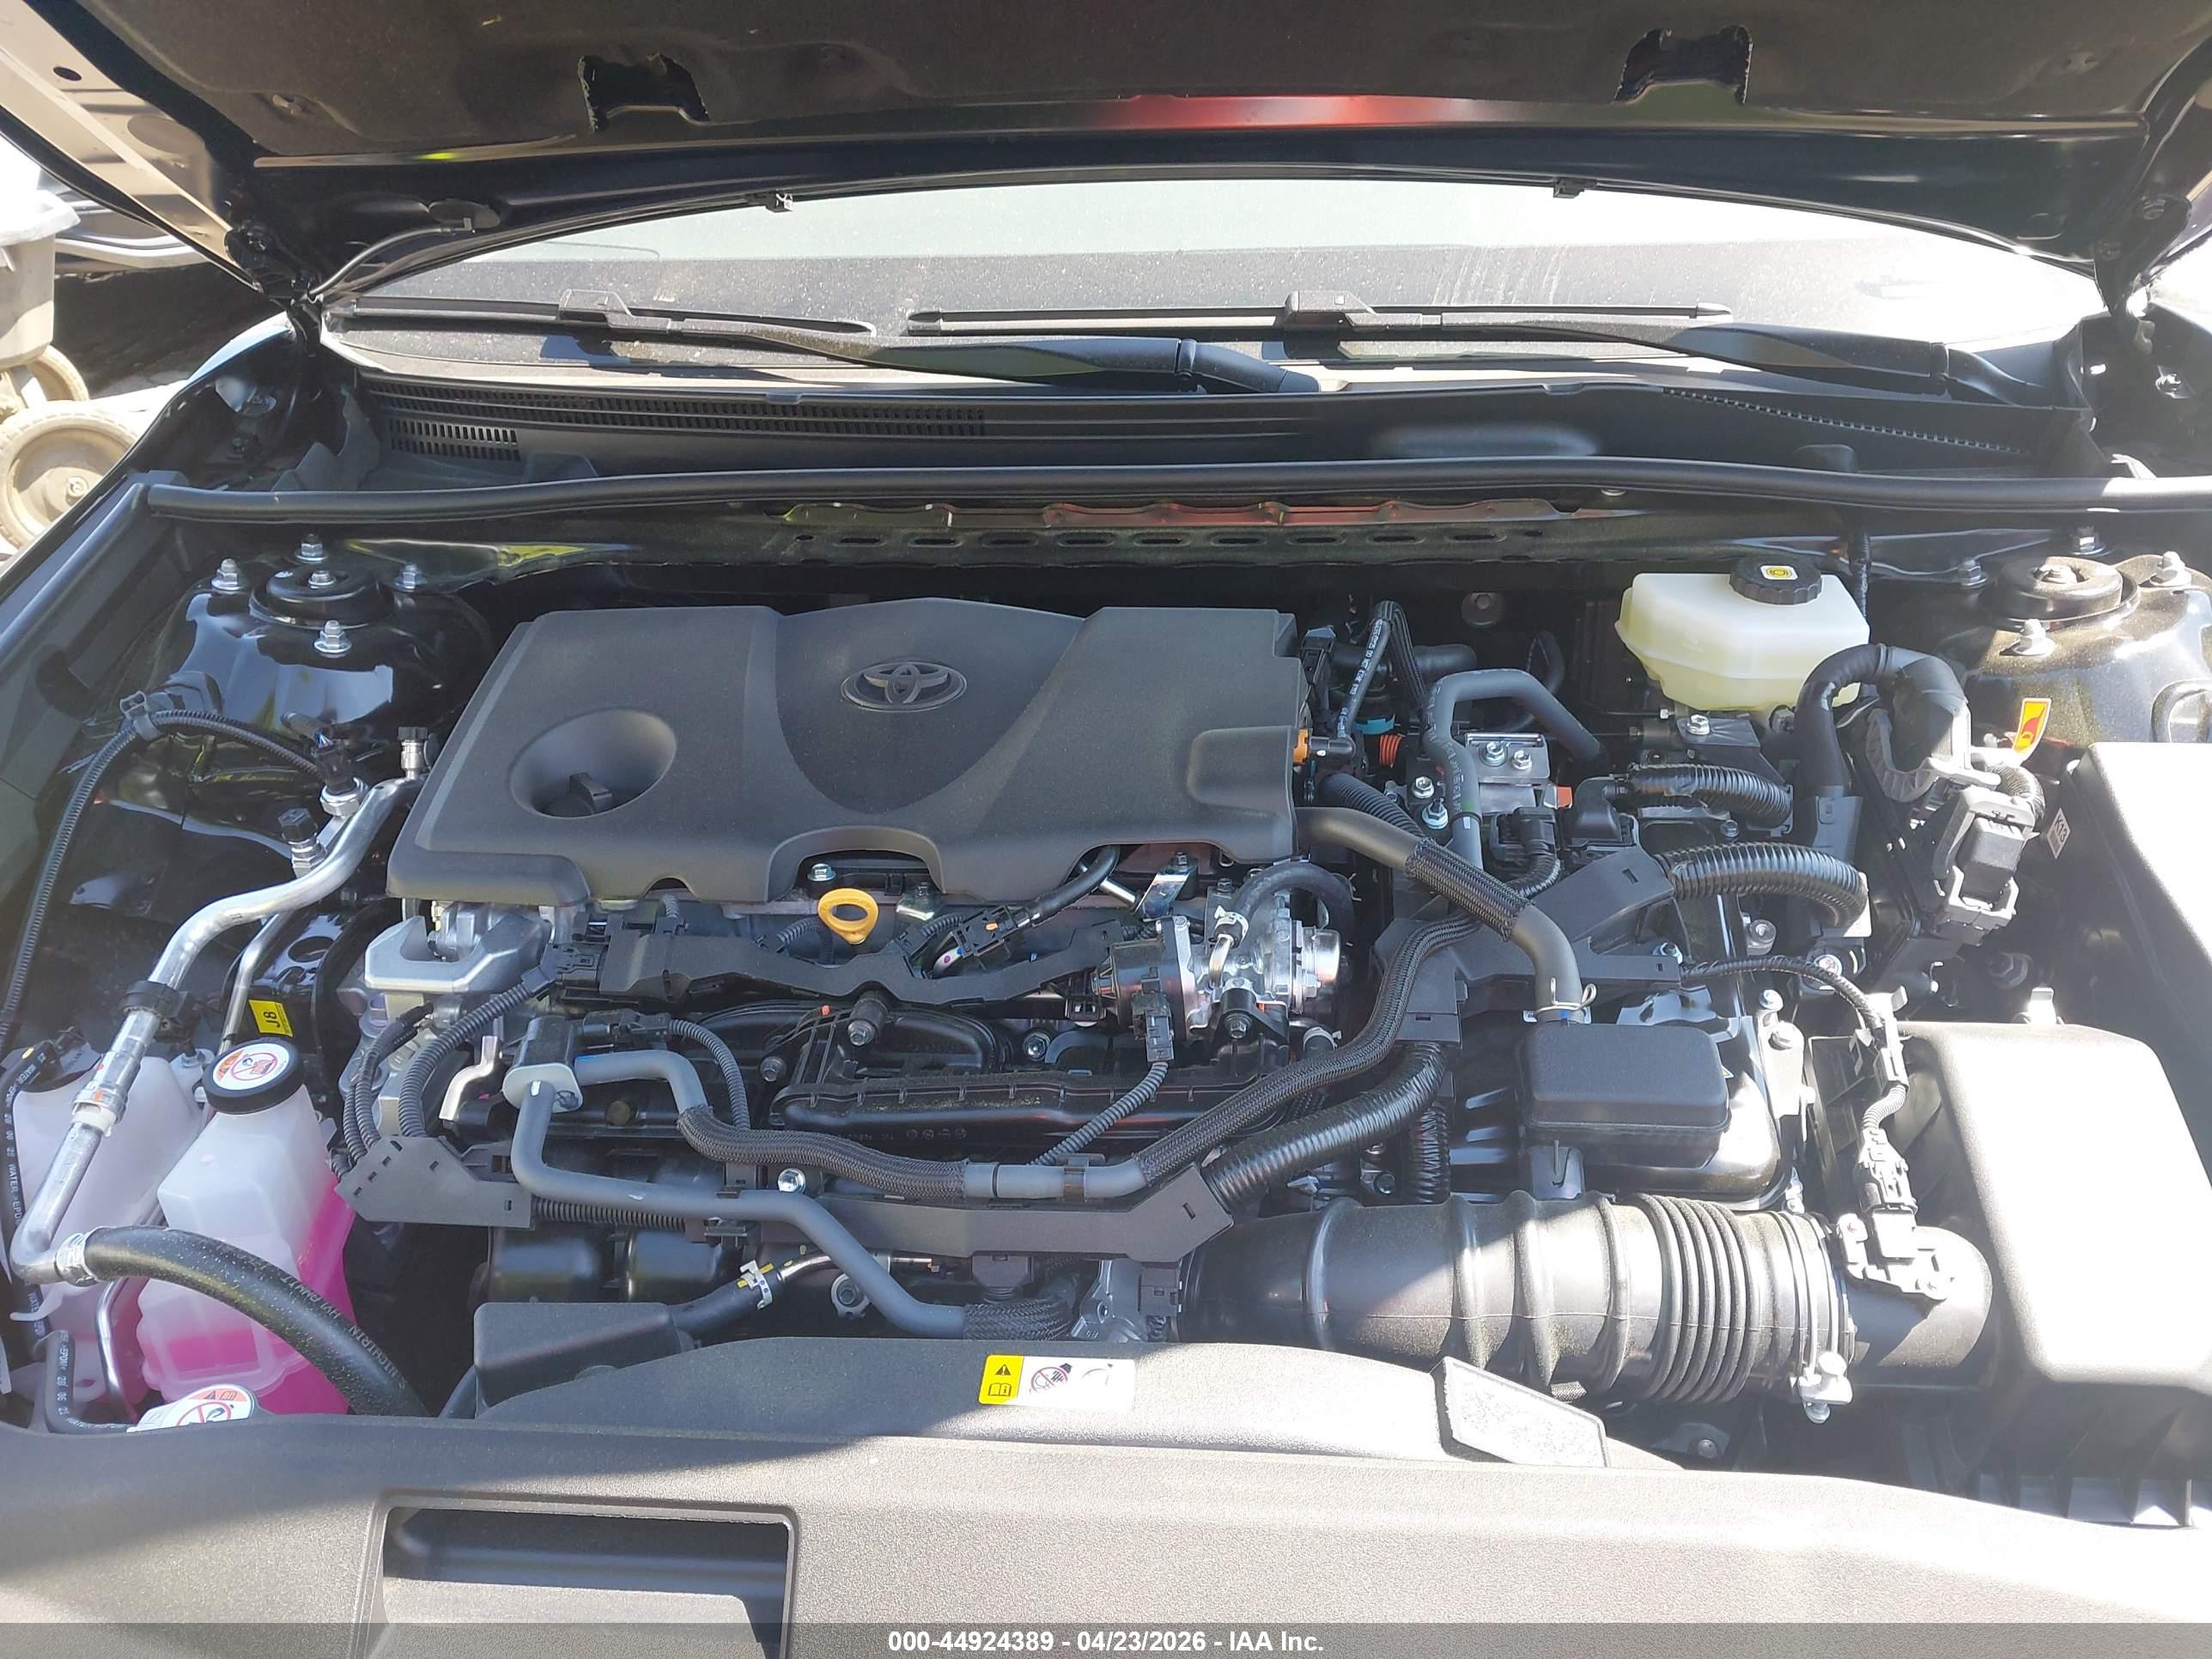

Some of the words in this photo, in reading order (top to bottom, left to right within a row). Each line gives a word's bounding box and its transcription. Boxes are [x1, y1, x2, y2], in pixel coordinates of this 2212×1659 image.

[2054, 814, 2068, 842] K13
[263, 1011, 281, 1028] J8
[8, 1164, 18, 1194] WATER
